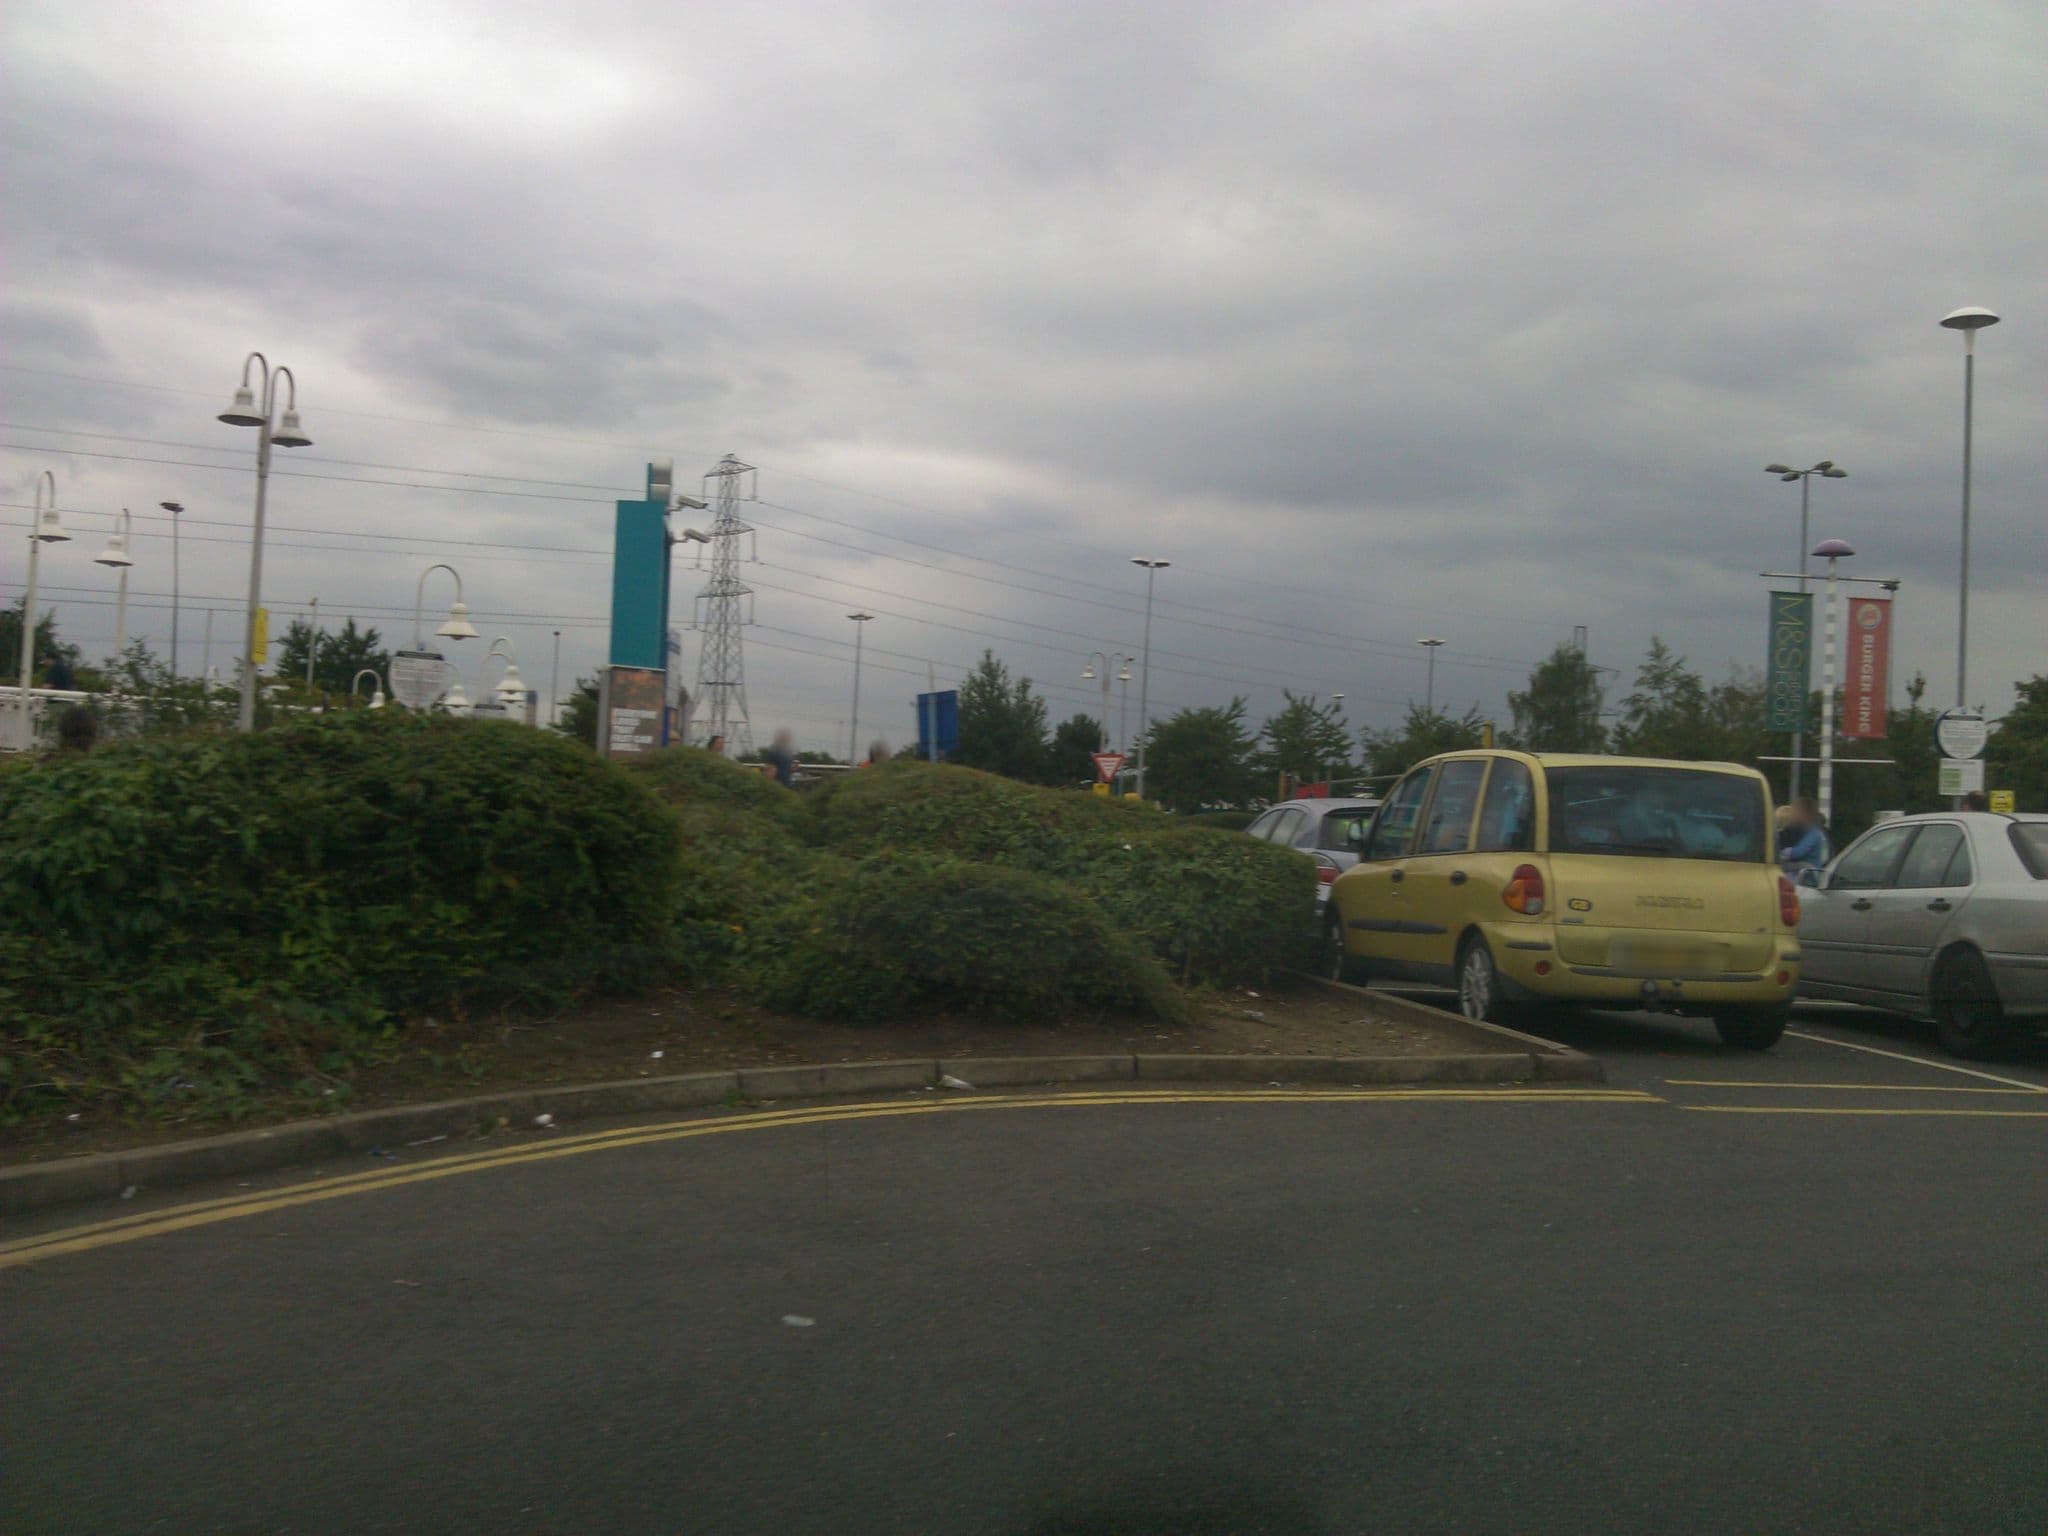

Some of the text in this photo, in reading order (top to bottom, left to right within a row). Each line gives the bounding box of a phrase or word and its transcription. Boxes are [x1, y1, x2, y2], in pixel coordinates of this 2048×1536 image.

[1775, 596, 1806, 669] M&S
[1861, 634, 1874, 692] BURGER
[1858, 696, 1871, 733] KING
